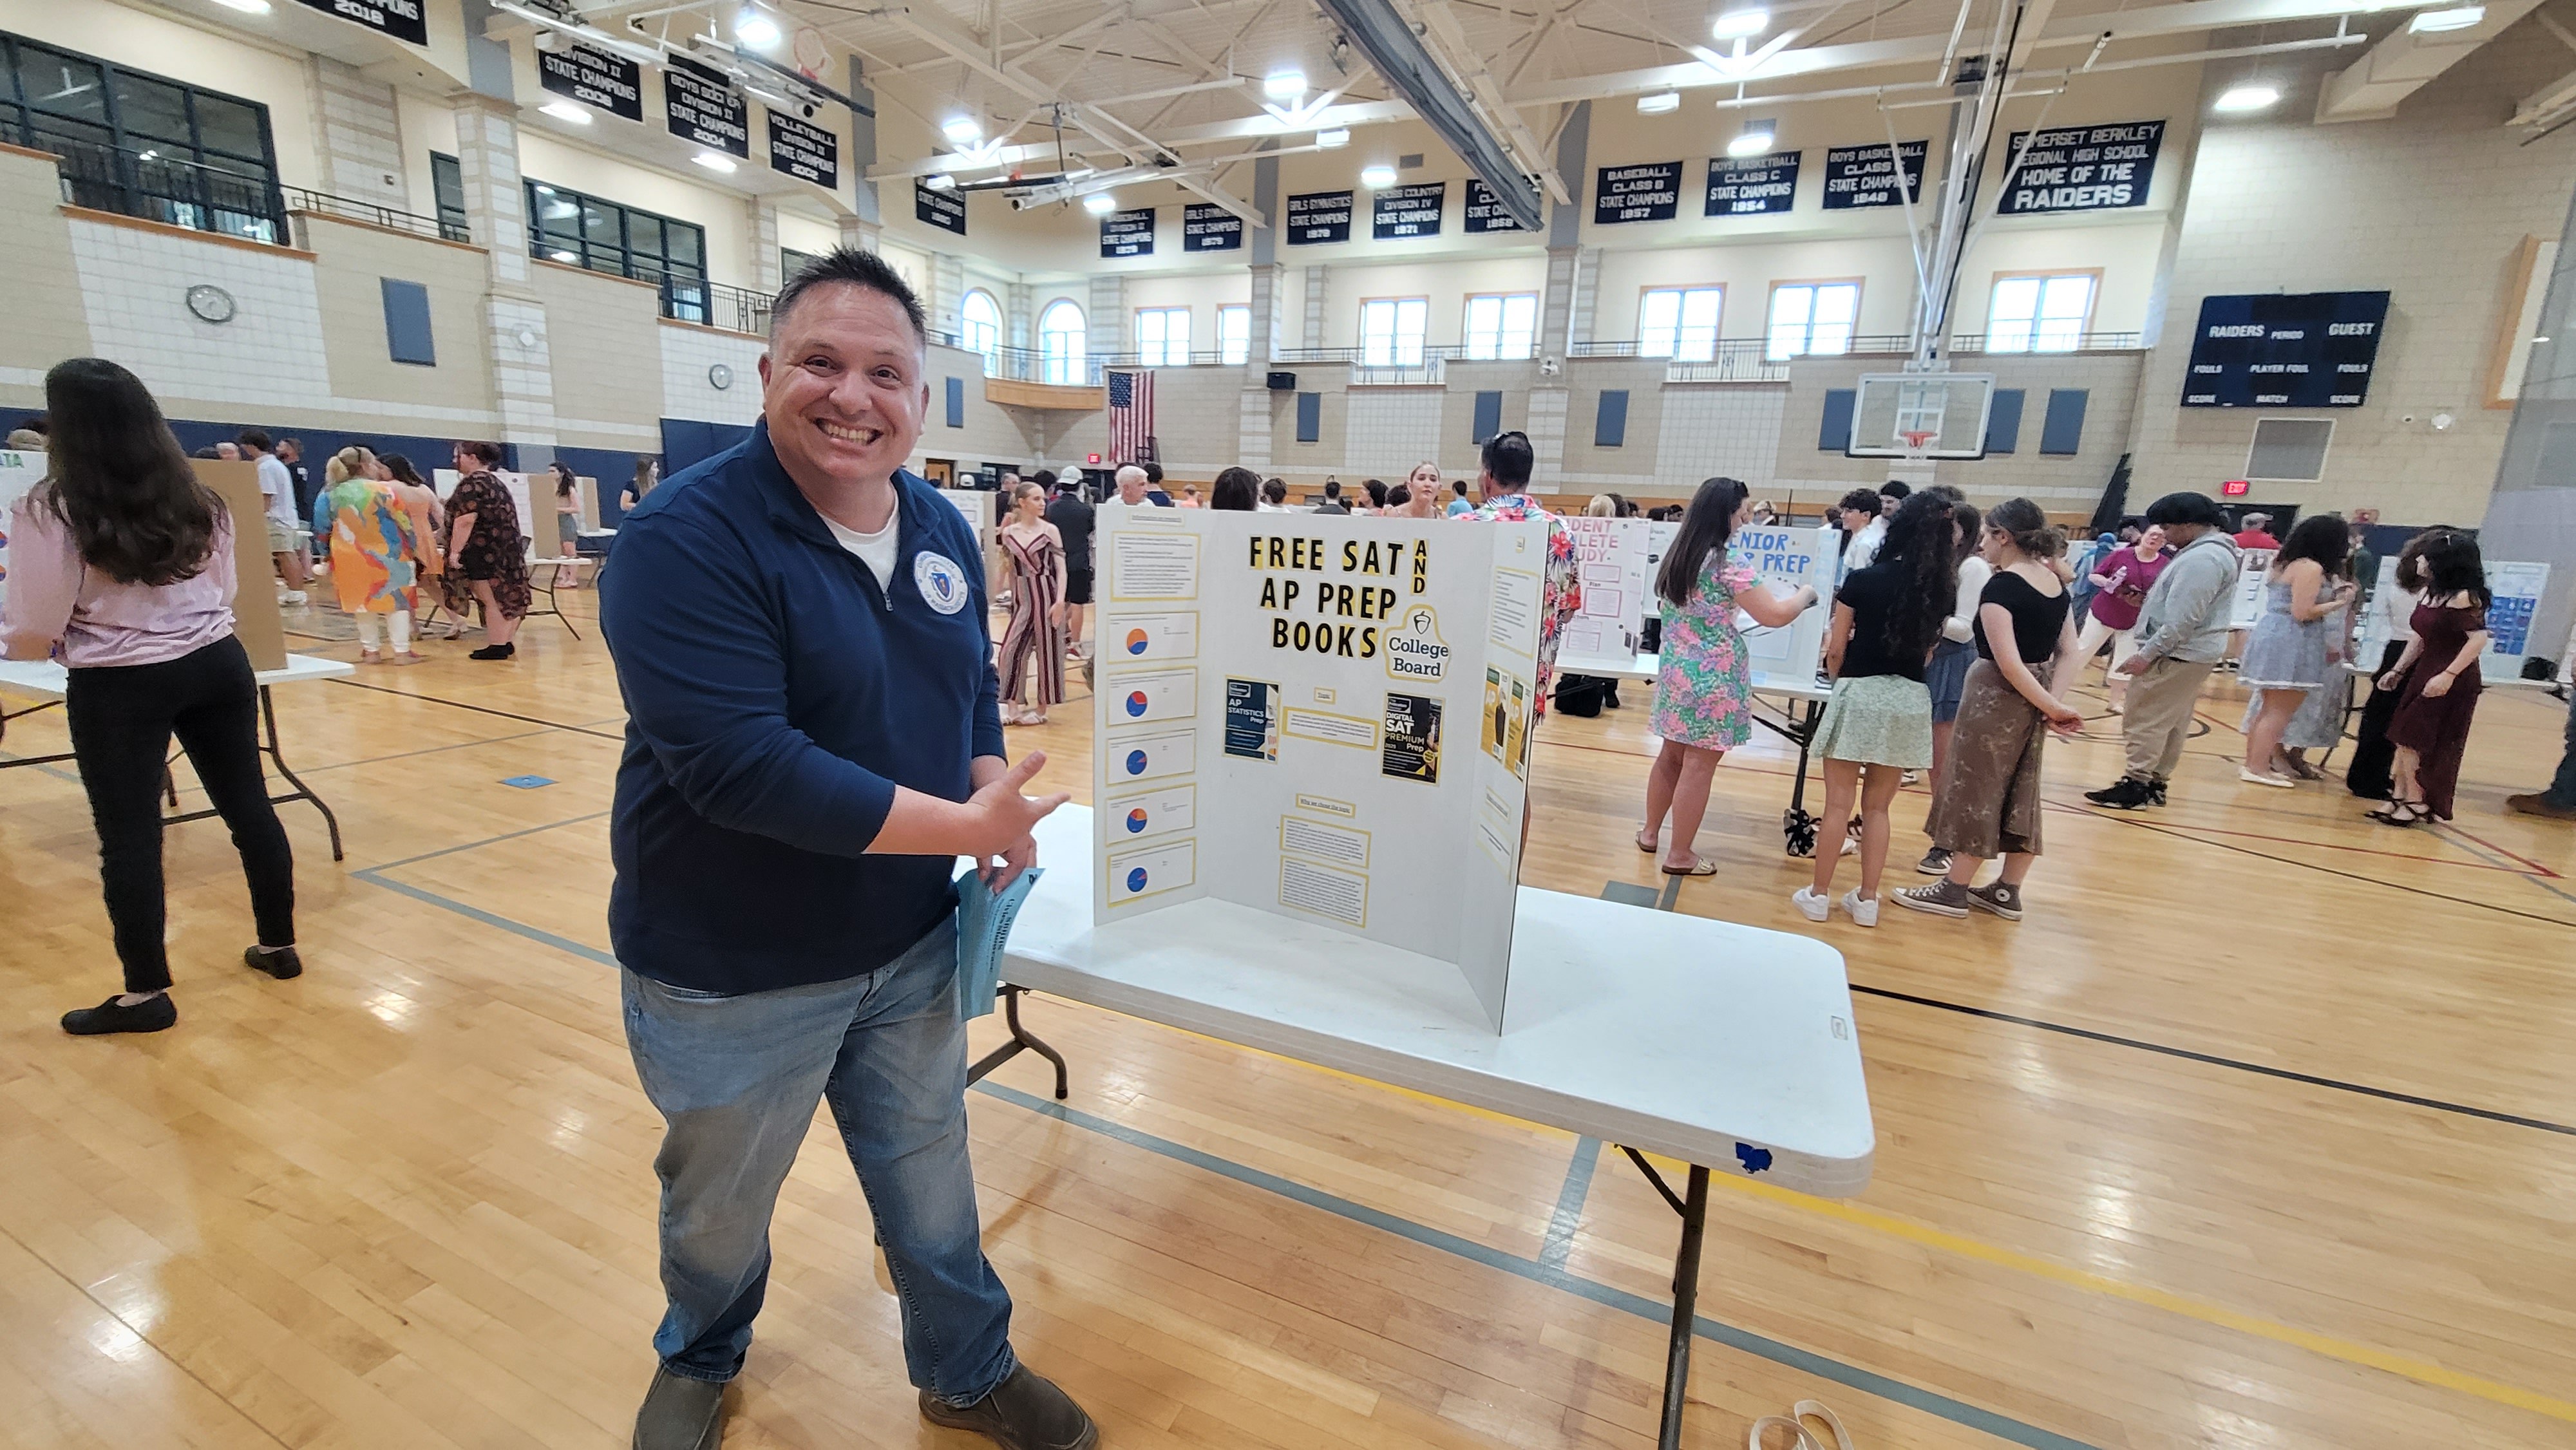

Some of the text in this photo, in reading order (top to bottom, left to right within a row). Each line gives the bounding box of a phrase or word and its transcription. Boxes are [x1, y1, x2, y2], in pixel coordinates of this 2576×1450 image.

[545, 55, 636, 101] STATE CHAMPIONS
[670, 73, 699, 95] BOYS
[681, 91, 723, 117] DIVISION
[670, 102, 745, 141] STATE CHAMPIONS
[693, 128, 726, 147] 2004
[770, 113, 835, 147] VOLLEYBALL
[2090, 125, 2159, 144] BERKLEY
[781, 131, 816, 152] DIVISION
[773, 141, 835, 173] STATE CHAMPIONS
[1830, 146, 1924, 163] BOYS BASKEBALL
[2014, 144, 2149, 167] EGIONAL HIGH SCHOOL
[1711, 155, 1797, 172] BOYS BASKETBALL
[1844, 162, 1892, 175] CLASS
[1607, 166, 1671, 181] BASEBALL
[1725, 169, 1781, 184] CLASS C
[2020, 162, 2136, 187] HOME OF THE
[1404, 185, 1444, 198] COUNTRY
[1612, 180, 1653, 193] CLASS
[1710, 182, 1792, 200] STATE CHAMPIONS
[1828, 177, 1859, 192] STATE
[918, 191, 935, 207] STATE
[1384, 198, 1433, 211] DIVISION IV
[1600, 191, 1674, 208] STATE CHAMPIONS
[2014, 183, 2133, 210] RAIDERS
[1468, 205, 1492, 218] STATE
[1620, 207, 1651, 220] 1957
[1731, 200, 1766, 212] 1954
[1290, 211, 1349, 227] STATE CHAMPIONS
[1376, 209, 1440, 225] STATE CHAMPIONS
[1186, 221, 1240, 235] STATE CHAMPIONS
[1394, 225, 1419, 235] 1971
[1102, 232, 1152, 245] STATE CHAMPIONS
[2209, 323, 2376, 340] RAIDERS PERIOD GUEST
[2193, 364, 2223, 374] FOULS
[2249, 364, 2309, 373] PLAYER FOUL
[2337, 363, 2369, 373] FOULS
[1250, 536, 1404, 576] FREE SAT
[1763, 553, 1811, 574] PREP
[1414, 540, 1427, 594] AND
[1260, 577, 1397, 620] AP PREP
[1273, 617, 1376, 659] BOOKS
[1388, 636, 1450, 659] College
[1392, 657, 1442, 677] Board
[1228, 698, 1242, 706] AP
[1227, 707, 1264, 717] STATISTICS
[1387, 711, 1415, 722] DIGITAL
[1385, 719, 1415, 735] SAT
[1385, 732, 1425, 745] PREMIUM
[1406, 743, 1424, 753] Prep
